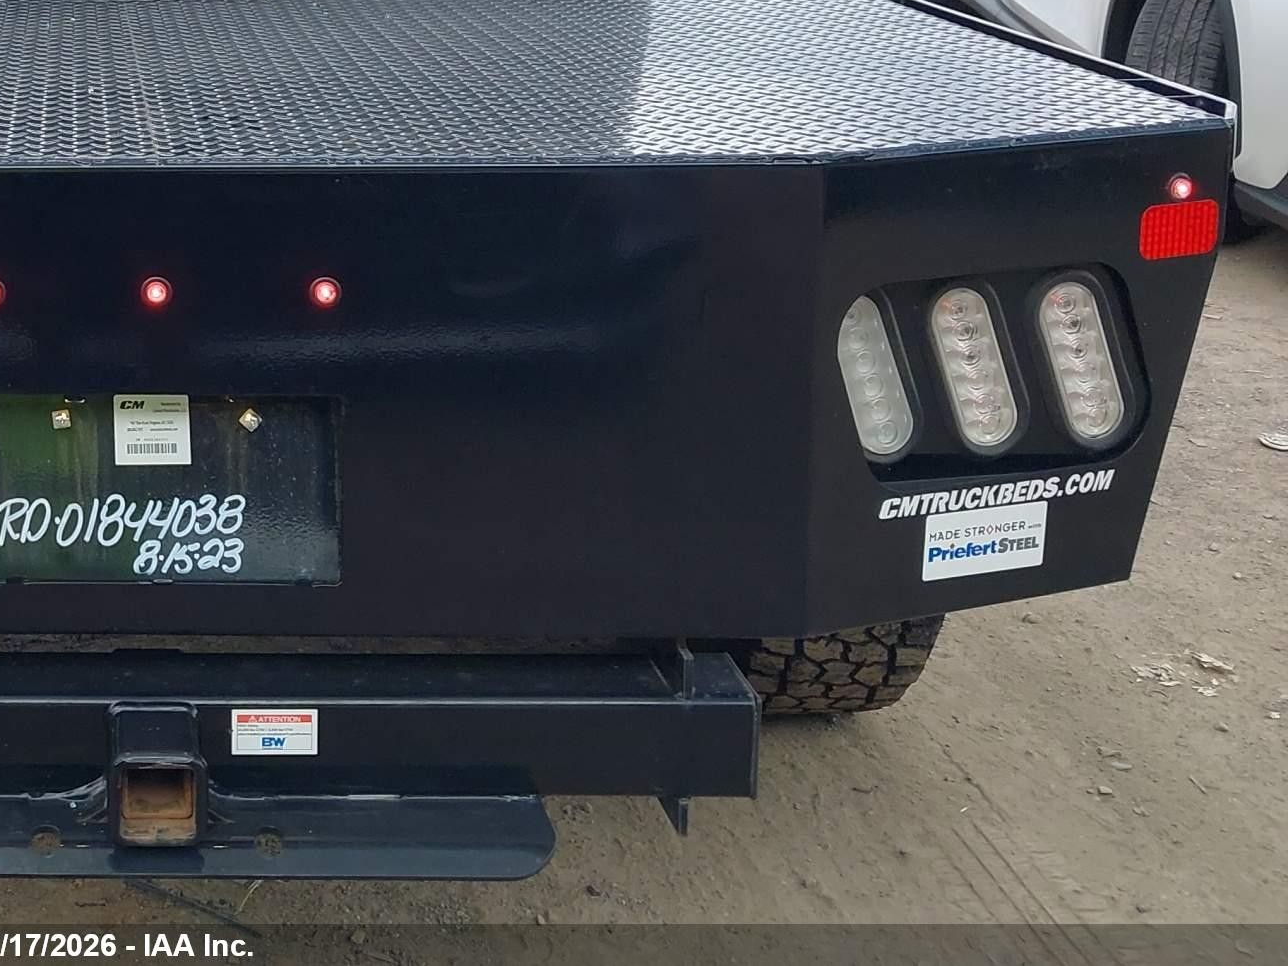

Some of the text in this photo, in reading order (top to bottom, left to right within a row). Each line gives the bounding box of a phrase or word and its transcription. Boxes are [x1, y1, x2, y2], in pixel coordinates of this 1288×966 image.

[120, 400, 145, 410] CM
[878, 469, 1116, 520] CMTRUCKBEDS.COM
[929, 521, 1026, 542] MADE STRONGER
